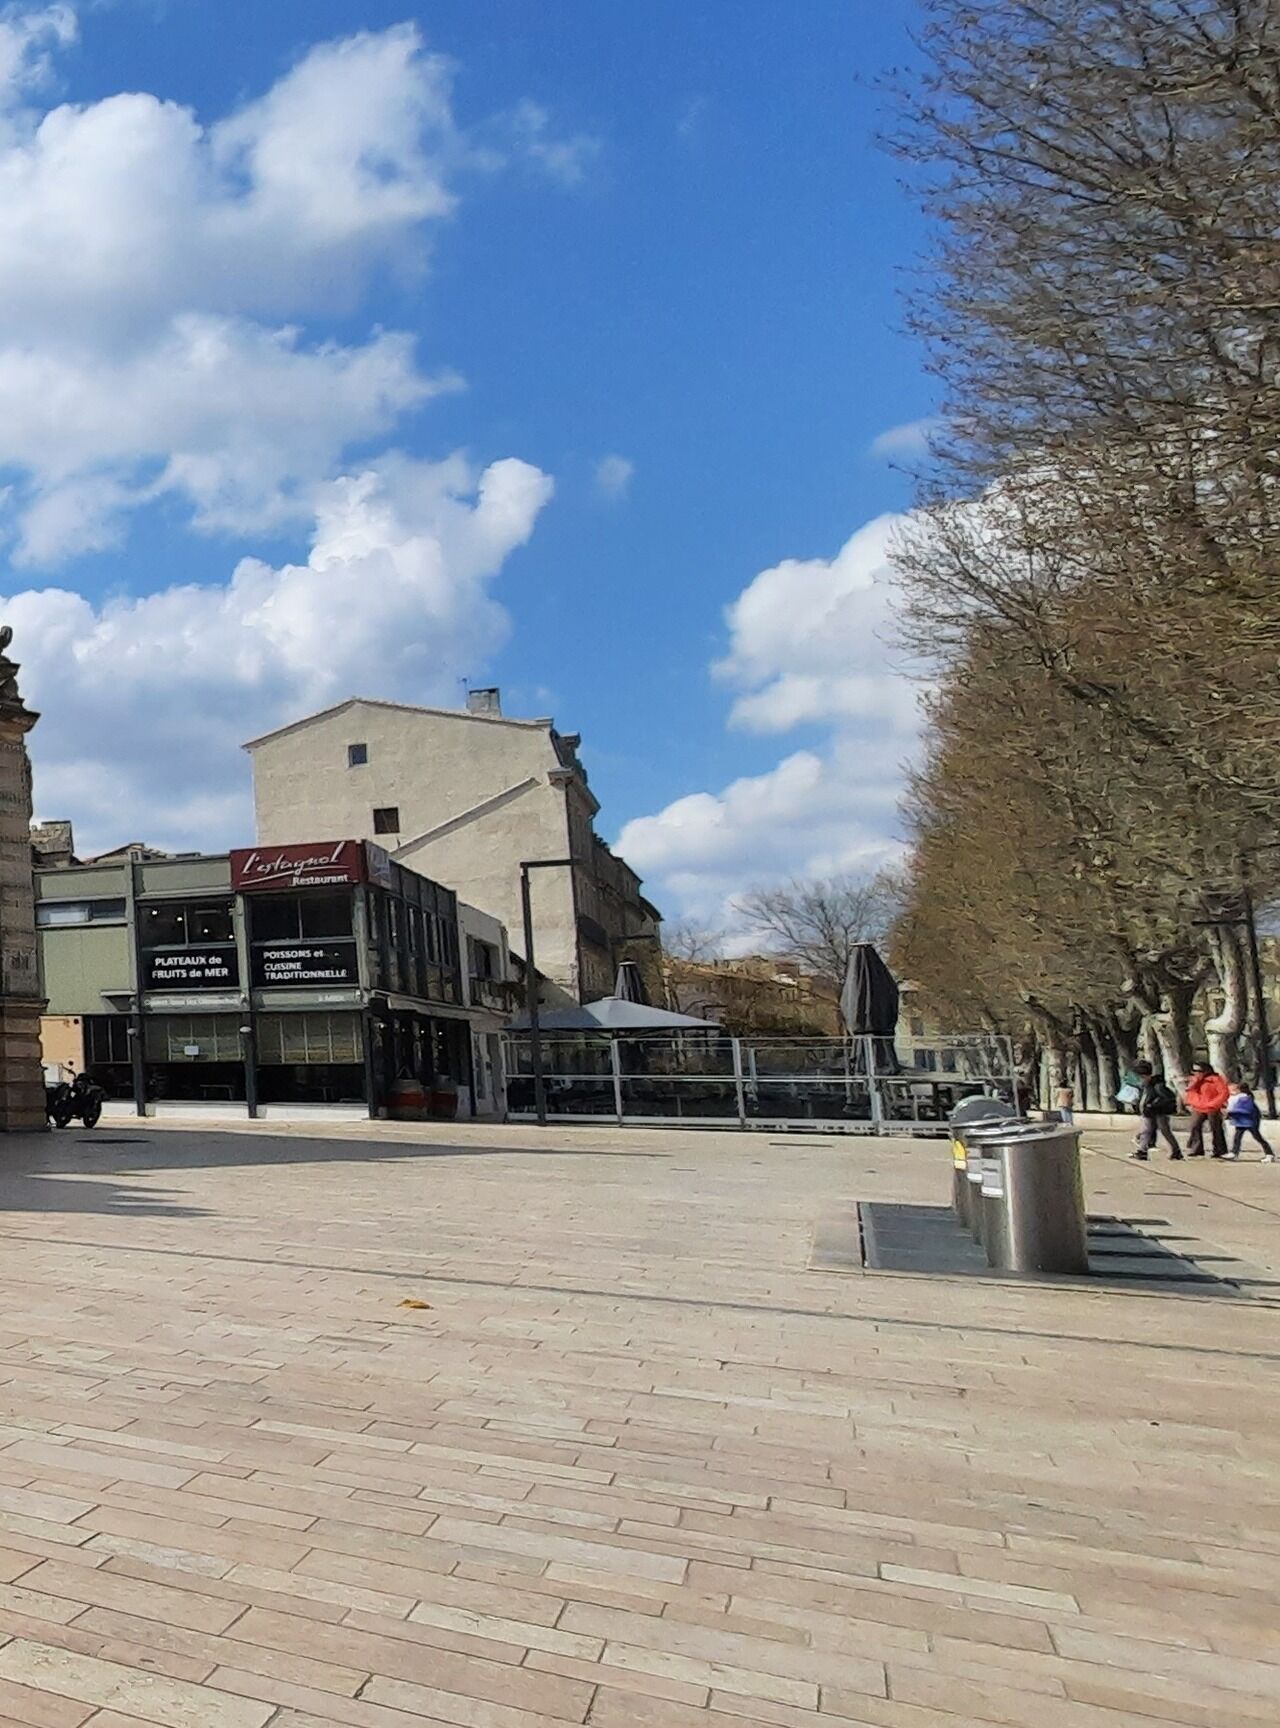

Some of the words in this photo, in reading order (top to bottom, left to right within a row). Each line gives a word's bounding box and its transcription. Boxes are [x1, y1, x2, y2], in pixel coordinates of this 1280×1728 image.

[292, 874, 348, 886] Restaurant
[263, 950, 312, 959] POISSONS
[313, 950, 324, 958] et
[155, 956, 206, 966] PLATEAUX
[208, 956, 222, 965] de
[264, 962, 302, 971] CUISINE
[152, 969, 187, 979] FRUITS
[189, 969, 203, 978] de
[204, 967, 229, 977] MER
[264, 969, 348, 980] TRADITIONNELLE
